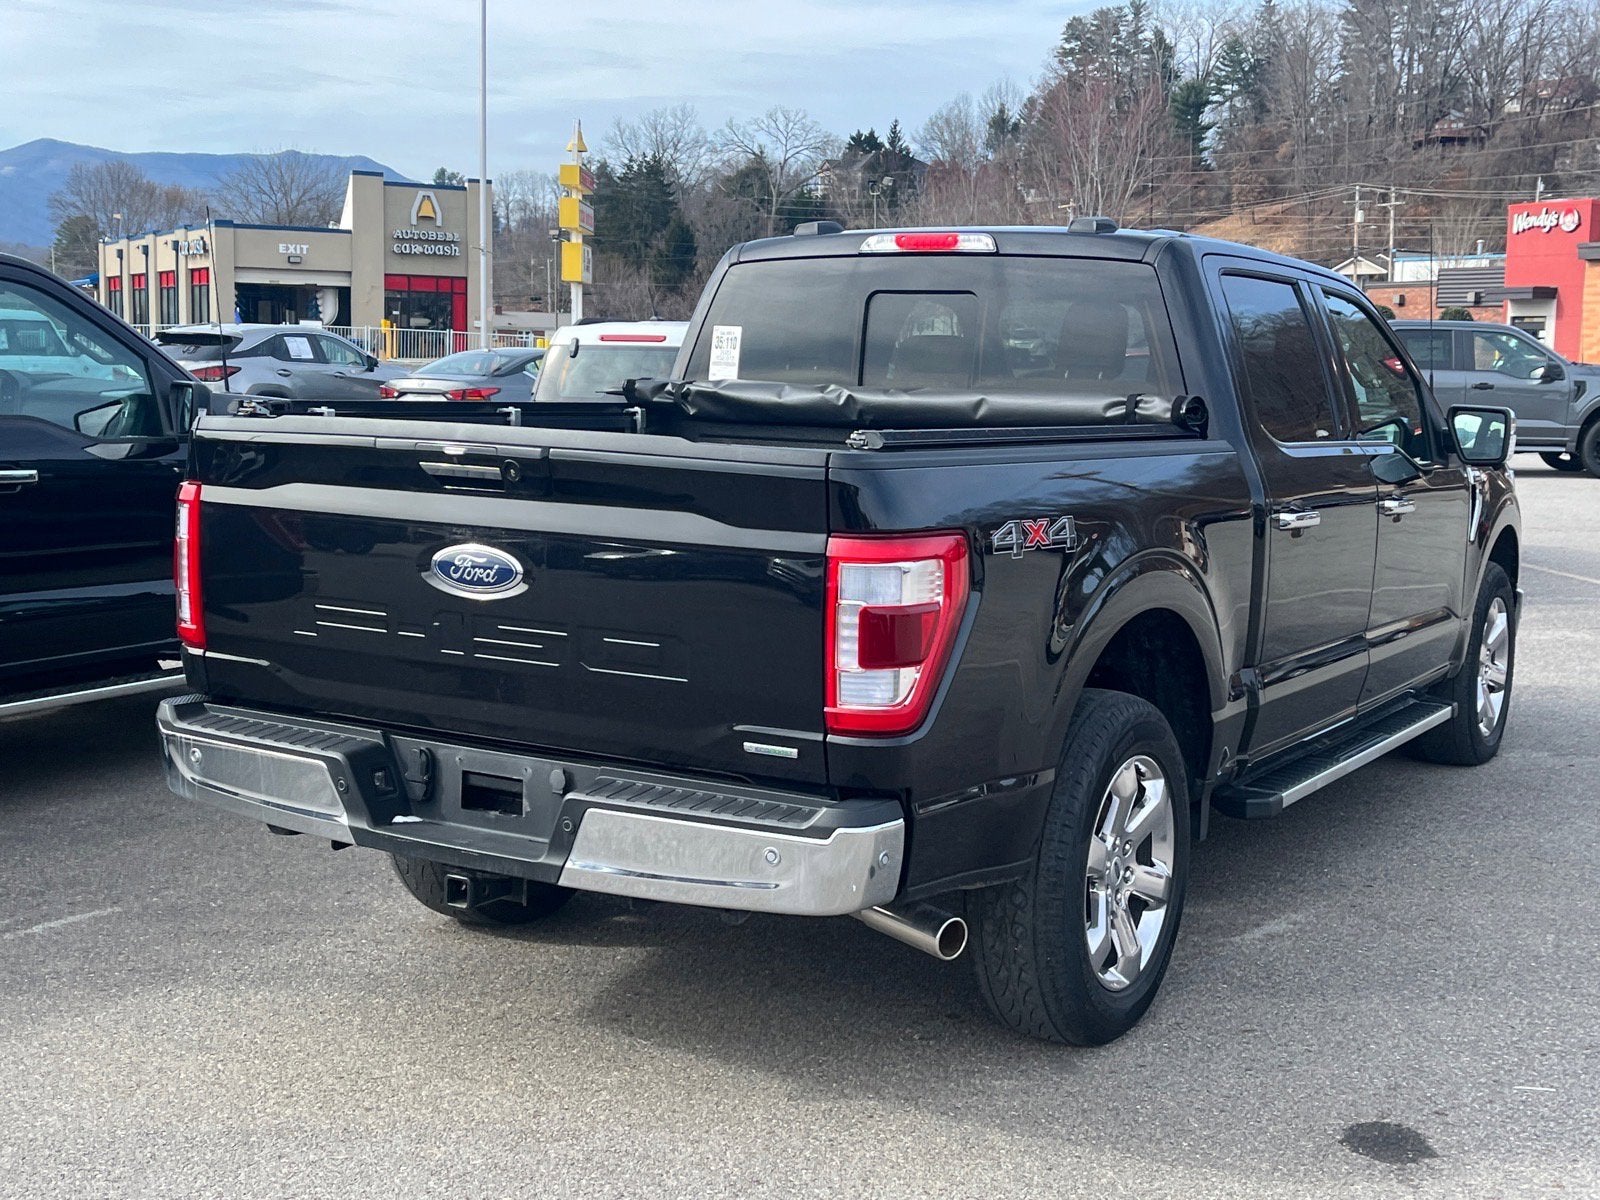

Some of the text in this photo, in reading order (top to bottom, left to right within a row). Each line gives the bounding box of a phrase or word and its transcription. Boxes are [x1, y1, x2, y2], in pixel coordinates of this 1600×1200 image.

[1512, 207, 1559, 234] Wendy's
[278, 243, 309, 254] EXIT
[449, 554, 500, 583] Ford
